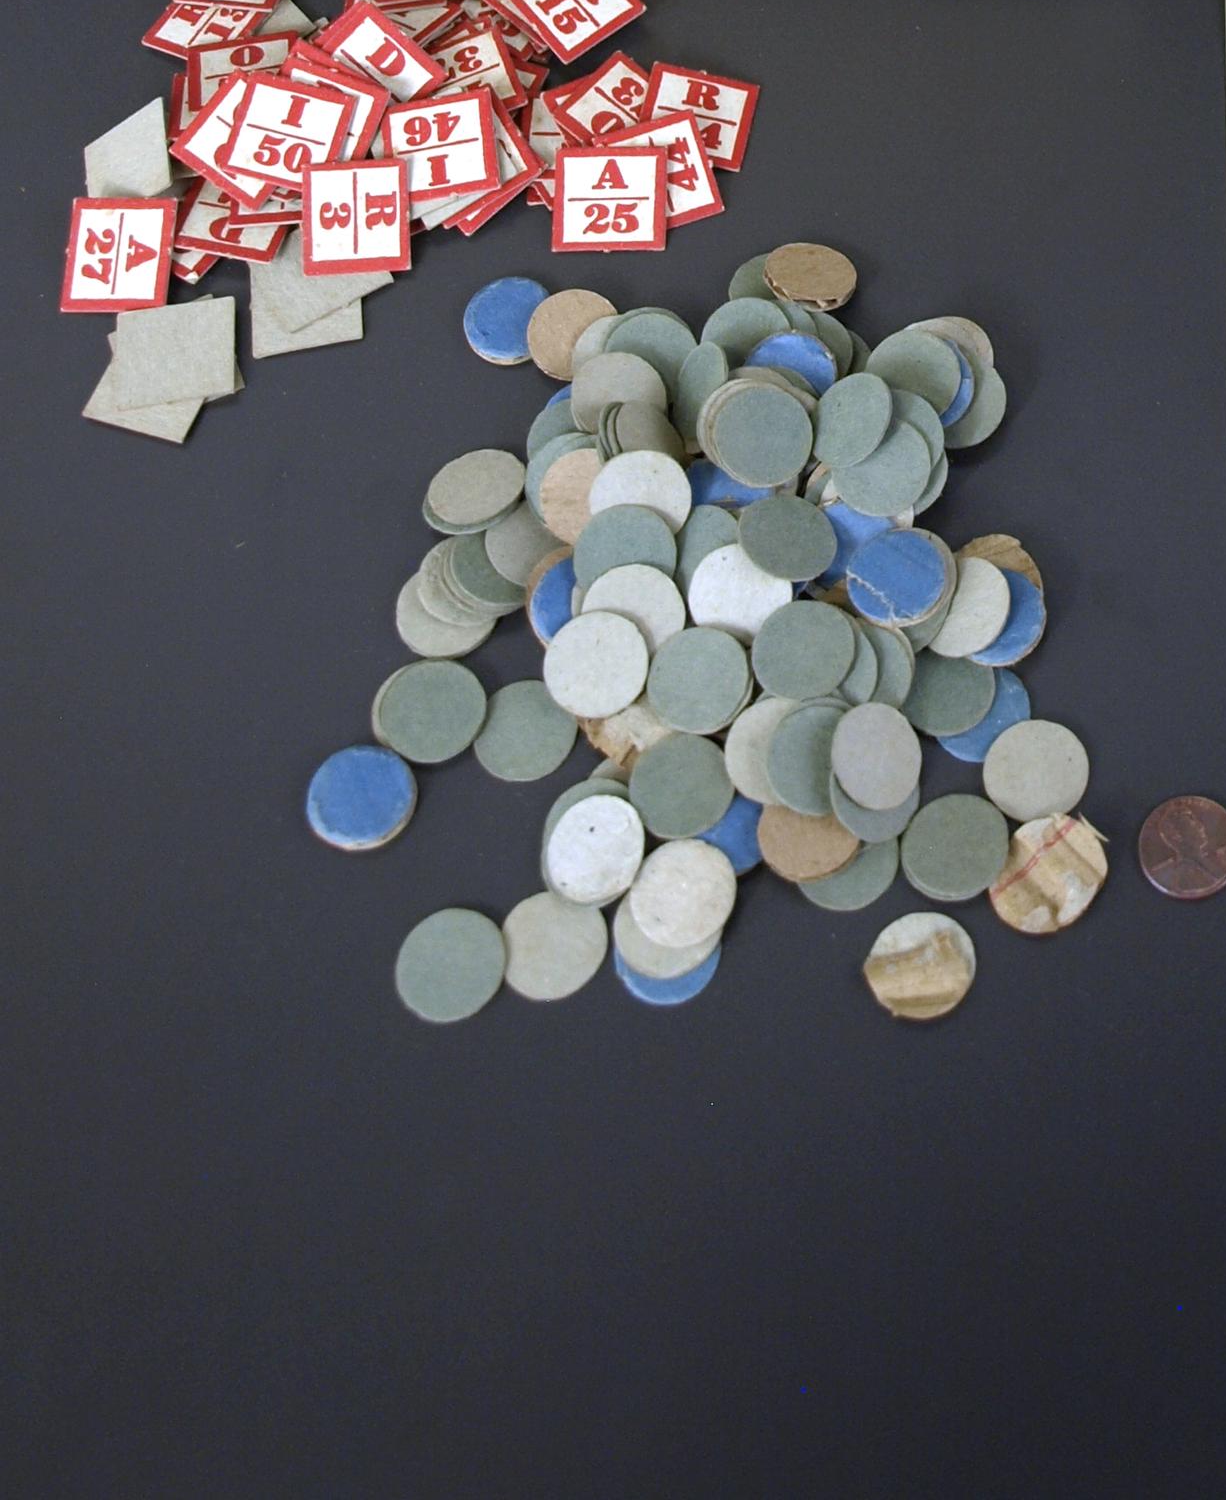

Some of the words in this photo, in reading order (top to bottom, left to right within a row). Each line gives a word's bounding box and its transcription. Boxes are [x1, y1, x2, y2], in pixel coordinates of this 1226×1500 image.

[366, 37, 405, 76] D
[281, 95, 310, 128] I
[682, 79, 721, 111] R
[403, 111, 460, 146] 46
[254, 134, 312, 173] 50
[428, 154, 450, 186] I
[668, 136, 699, 192] 44
[592, 159, 629, 190] A
[319, 202, 349, 230] 3
[364, 191, 398, 231] R
[582, 202, 640, 234] 25
[81, 228, 116, 284] 27
[125, 234, 158, 273] A
